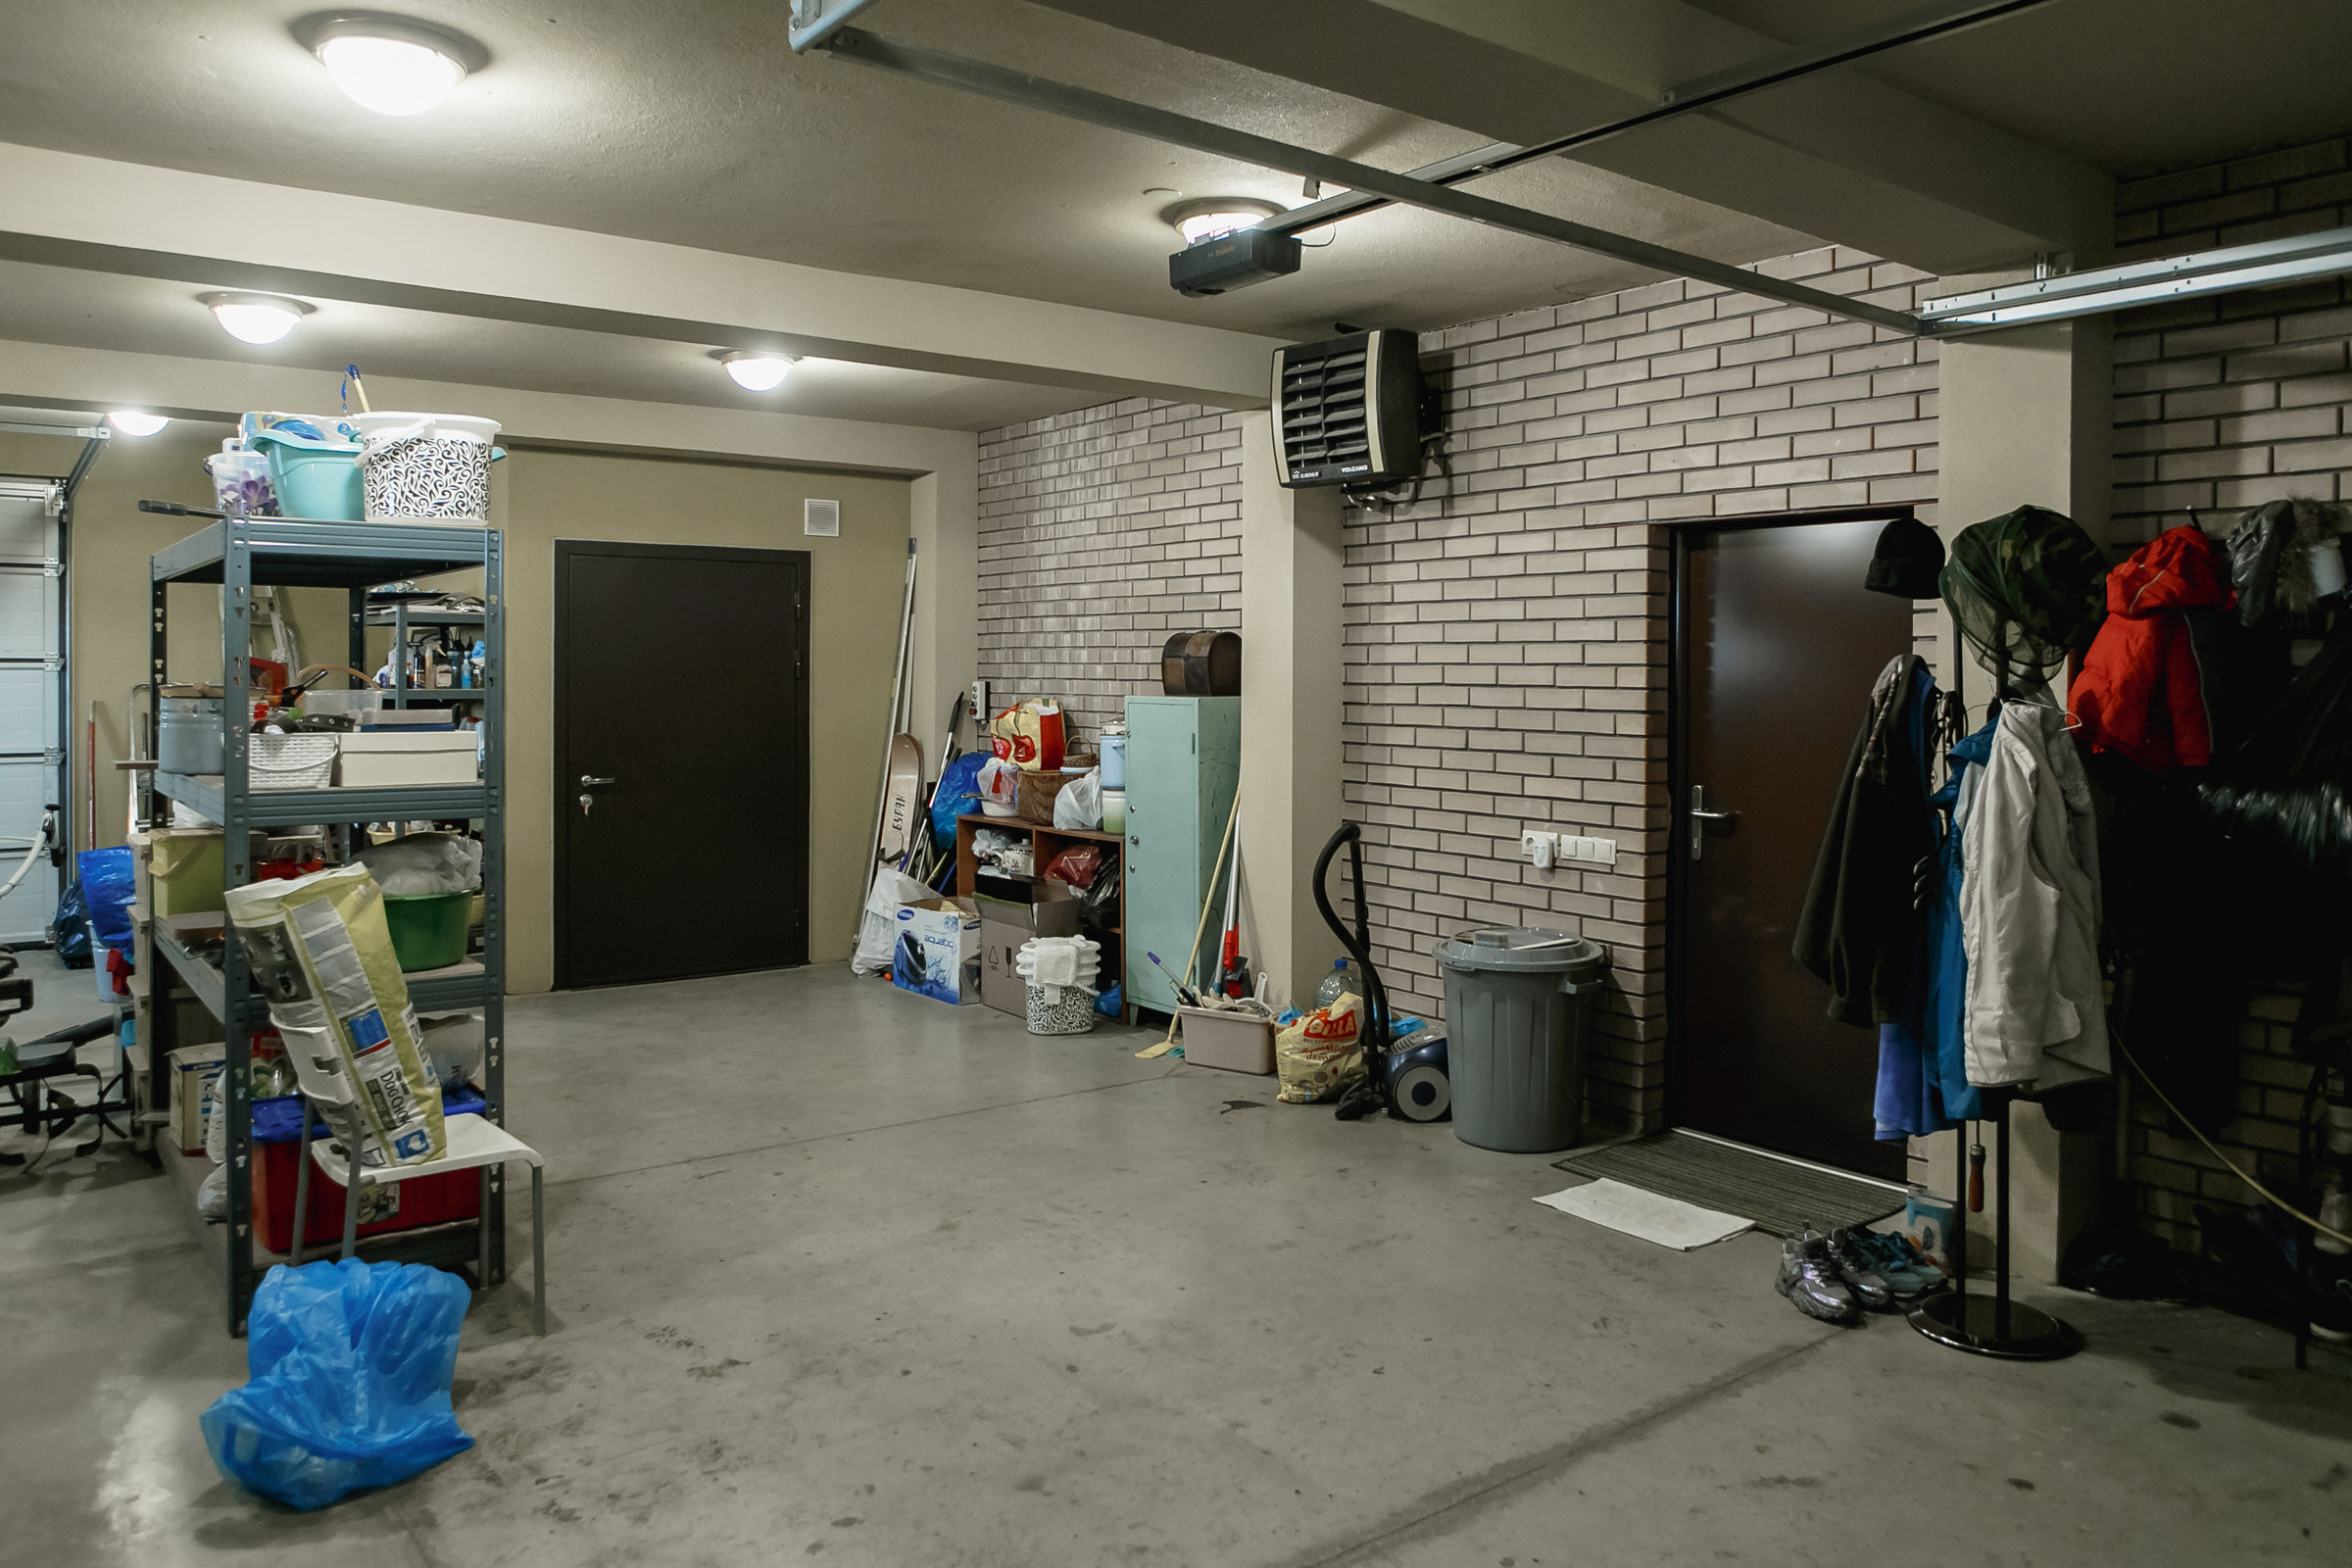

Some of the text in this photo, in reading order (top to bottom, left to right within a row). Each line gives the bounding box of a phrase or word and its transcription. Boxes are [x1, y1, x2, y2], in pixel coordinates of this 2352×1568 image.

[1341, 464, 1368, 473] VOLCANO
[892, 794, 906, 831] БУРАН
[1308, 1015, 1355, 1036] BILLA
[380, 1070, 400, 1099] DOG
